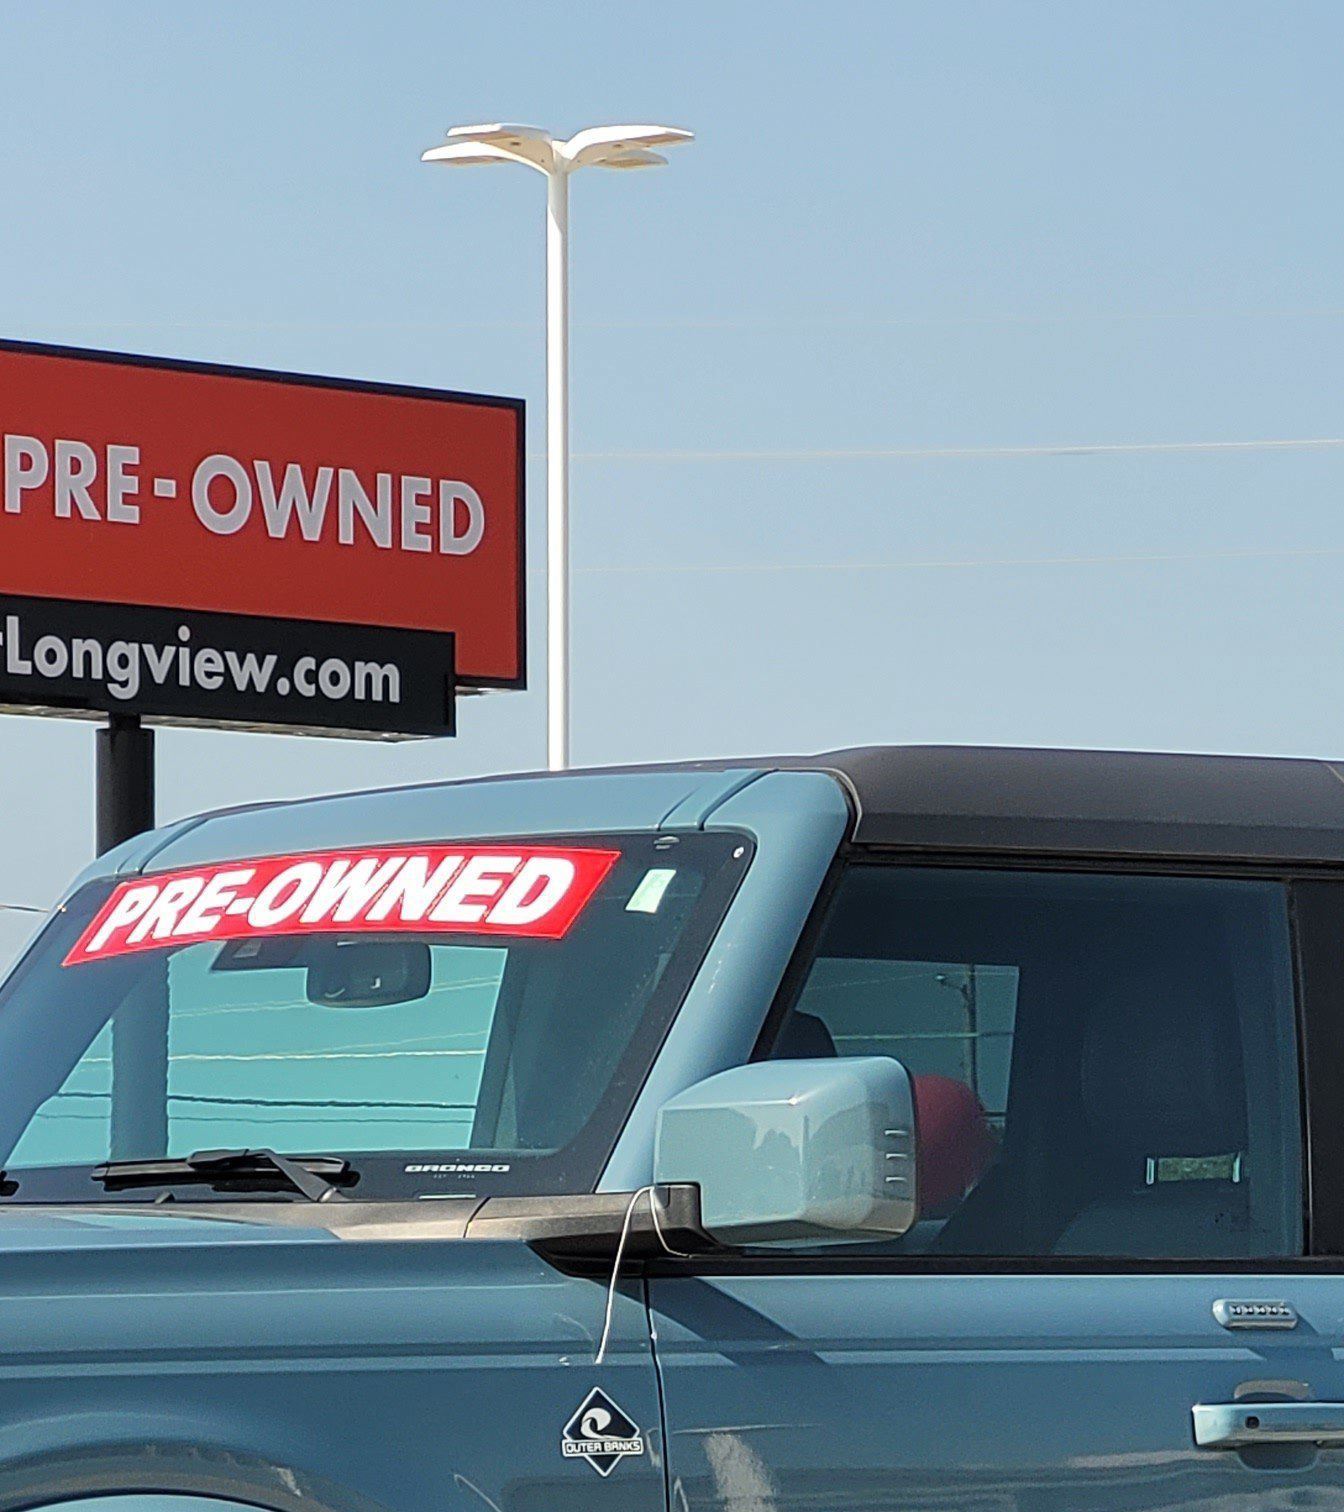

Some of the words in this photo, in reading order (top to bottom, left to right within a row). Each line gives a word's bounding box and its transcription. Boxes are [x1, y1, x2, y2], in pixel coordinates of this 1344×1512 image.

[4, 434, 485, 556] PRE-OWNED
[84, 855, 577, 954] PRE-OWNED
[565, 1442, 602, 1453] OUTER
[604, 1440, 641, 1452] BANKS
